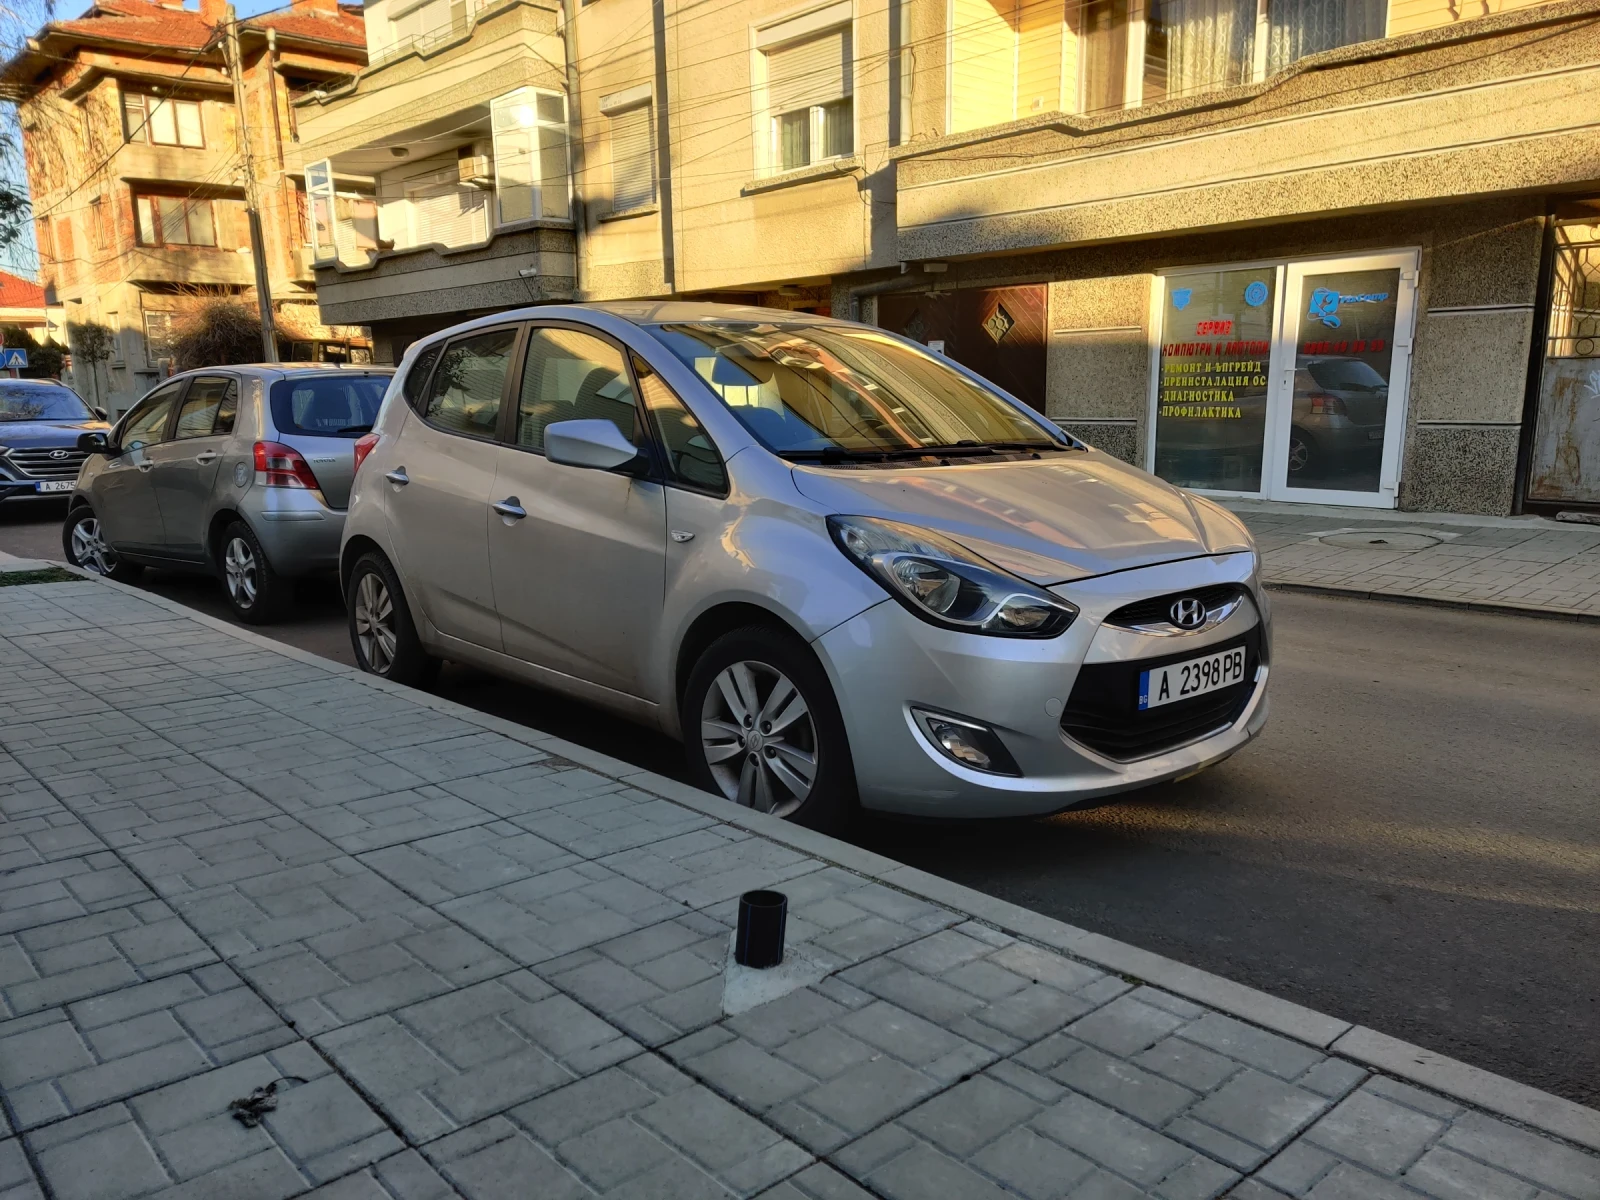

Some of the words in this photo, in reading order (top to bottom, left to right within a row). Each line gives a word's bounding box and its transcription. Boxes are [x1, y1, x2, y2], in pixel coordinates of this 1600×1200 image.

[1164, 363, 1202, 373] РЕМОНТ
[1252, 375, 1267, 386] ОС
[1163, 390, 1235, 403] ДИАГНОСТИКА
[1162, 405, 1242, 418] ПРОФИЛАКТИКА
[1158, 670, 1170, 701] A
[1138, 694, 1148, 705] BG
